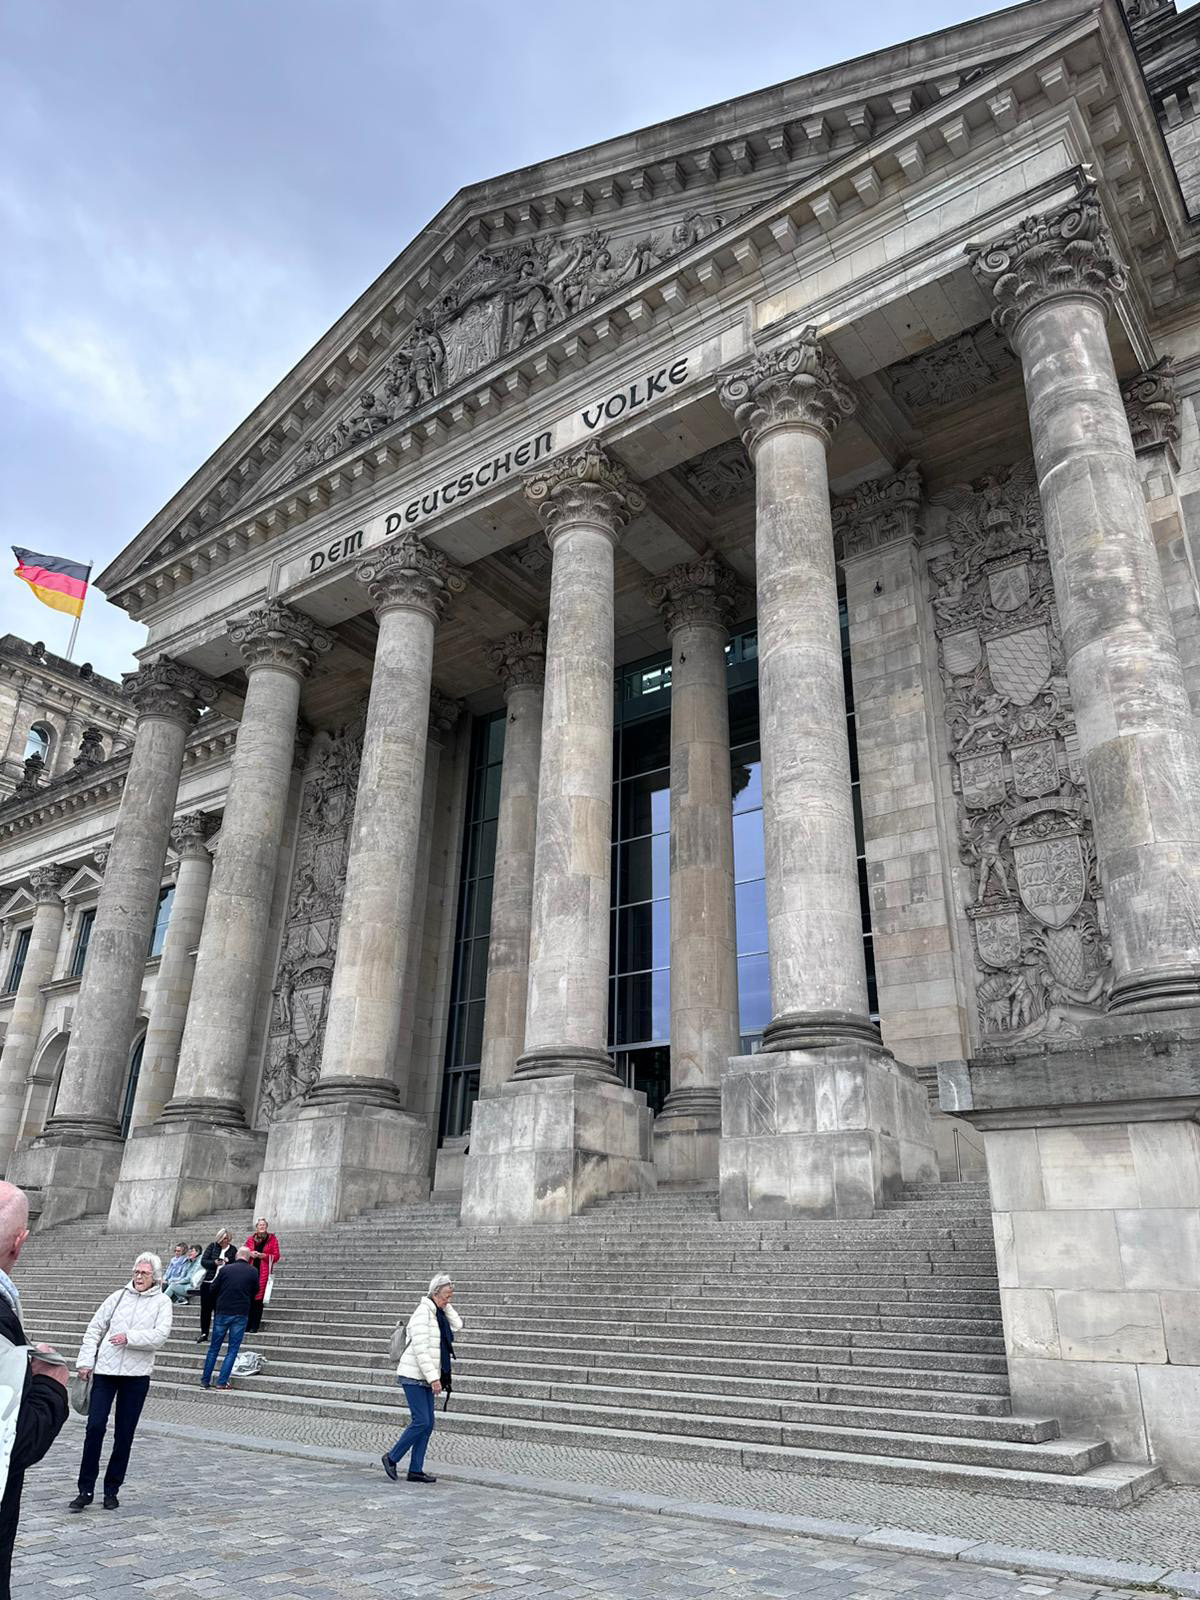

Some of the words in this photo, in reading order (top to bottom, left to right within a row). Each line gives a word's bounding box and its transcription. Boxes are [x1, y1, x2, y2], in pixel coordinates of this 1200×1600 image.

[309, 530, 364, 573] DEM
[384, 431, 552, 536] DEUTSCHEN
[581, 357, 689, 429] VOLKE
